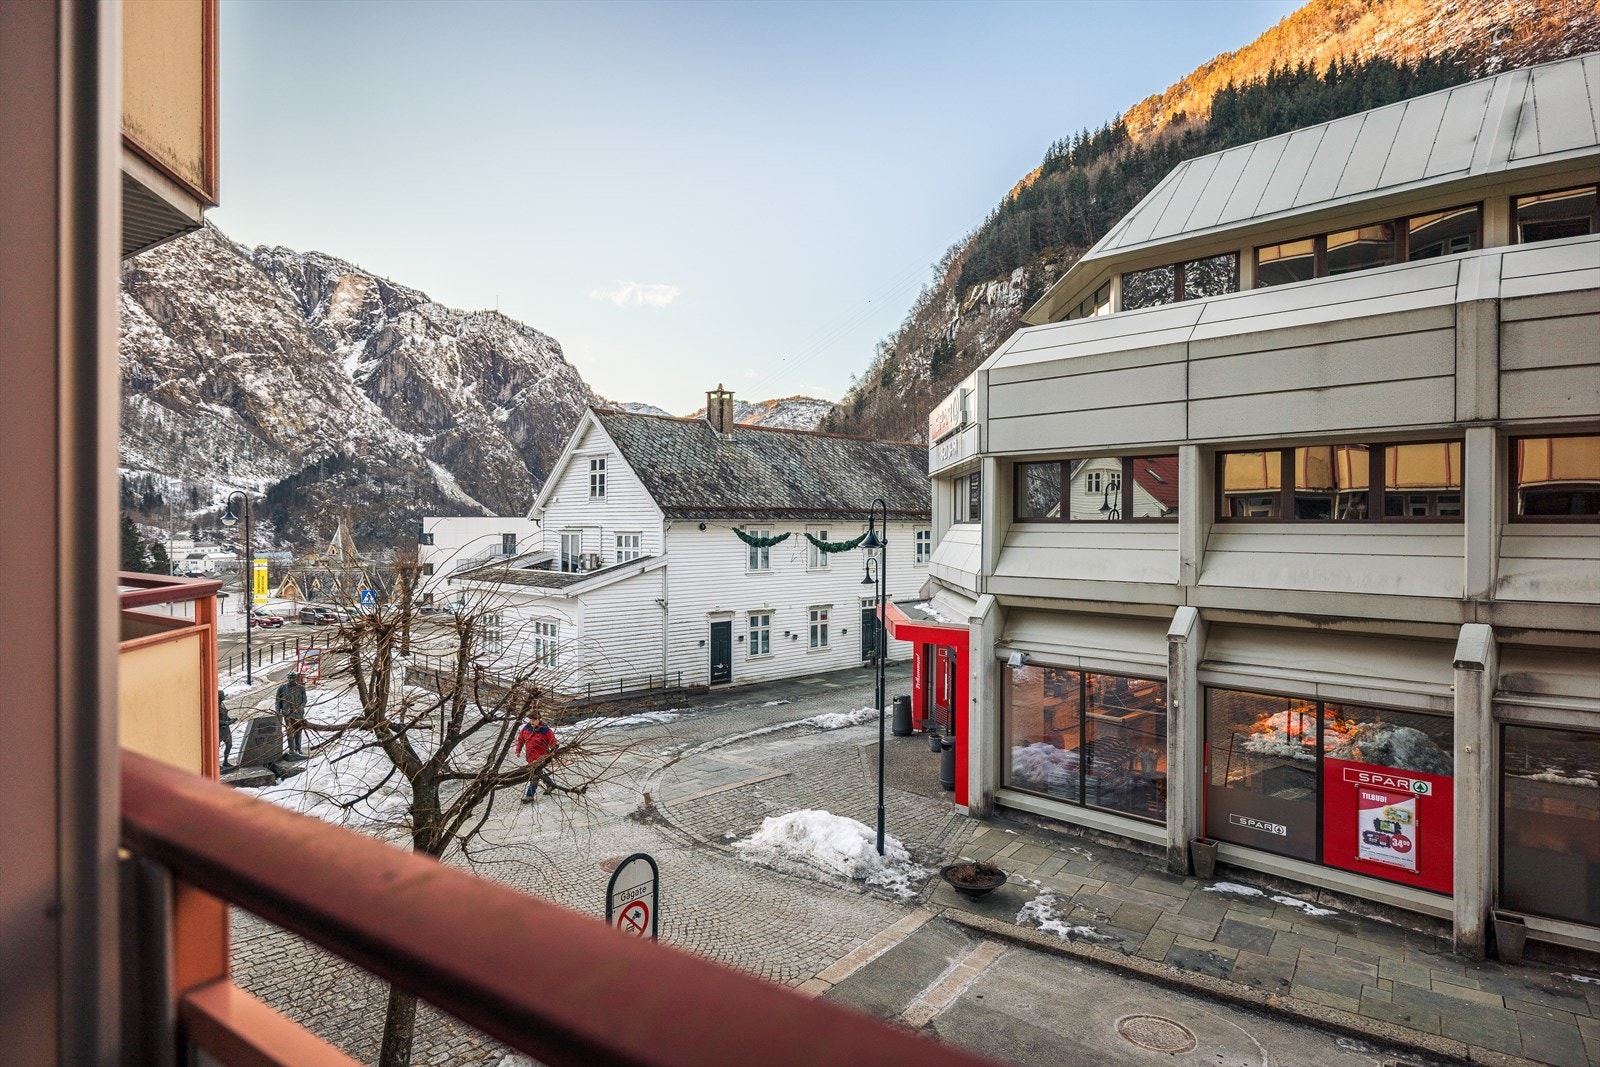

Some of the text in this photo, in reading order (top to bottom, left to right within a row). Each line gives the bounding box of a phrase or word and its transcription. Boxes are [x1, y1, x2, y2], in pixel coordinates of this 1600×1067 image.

[1358, 773, 1409, 789] SPAR
[1361, 792, 1387, 803] TILBUD!
[1239, 817, 1272, 831] SPAR
[620, 886, 647, 902] Gågate
